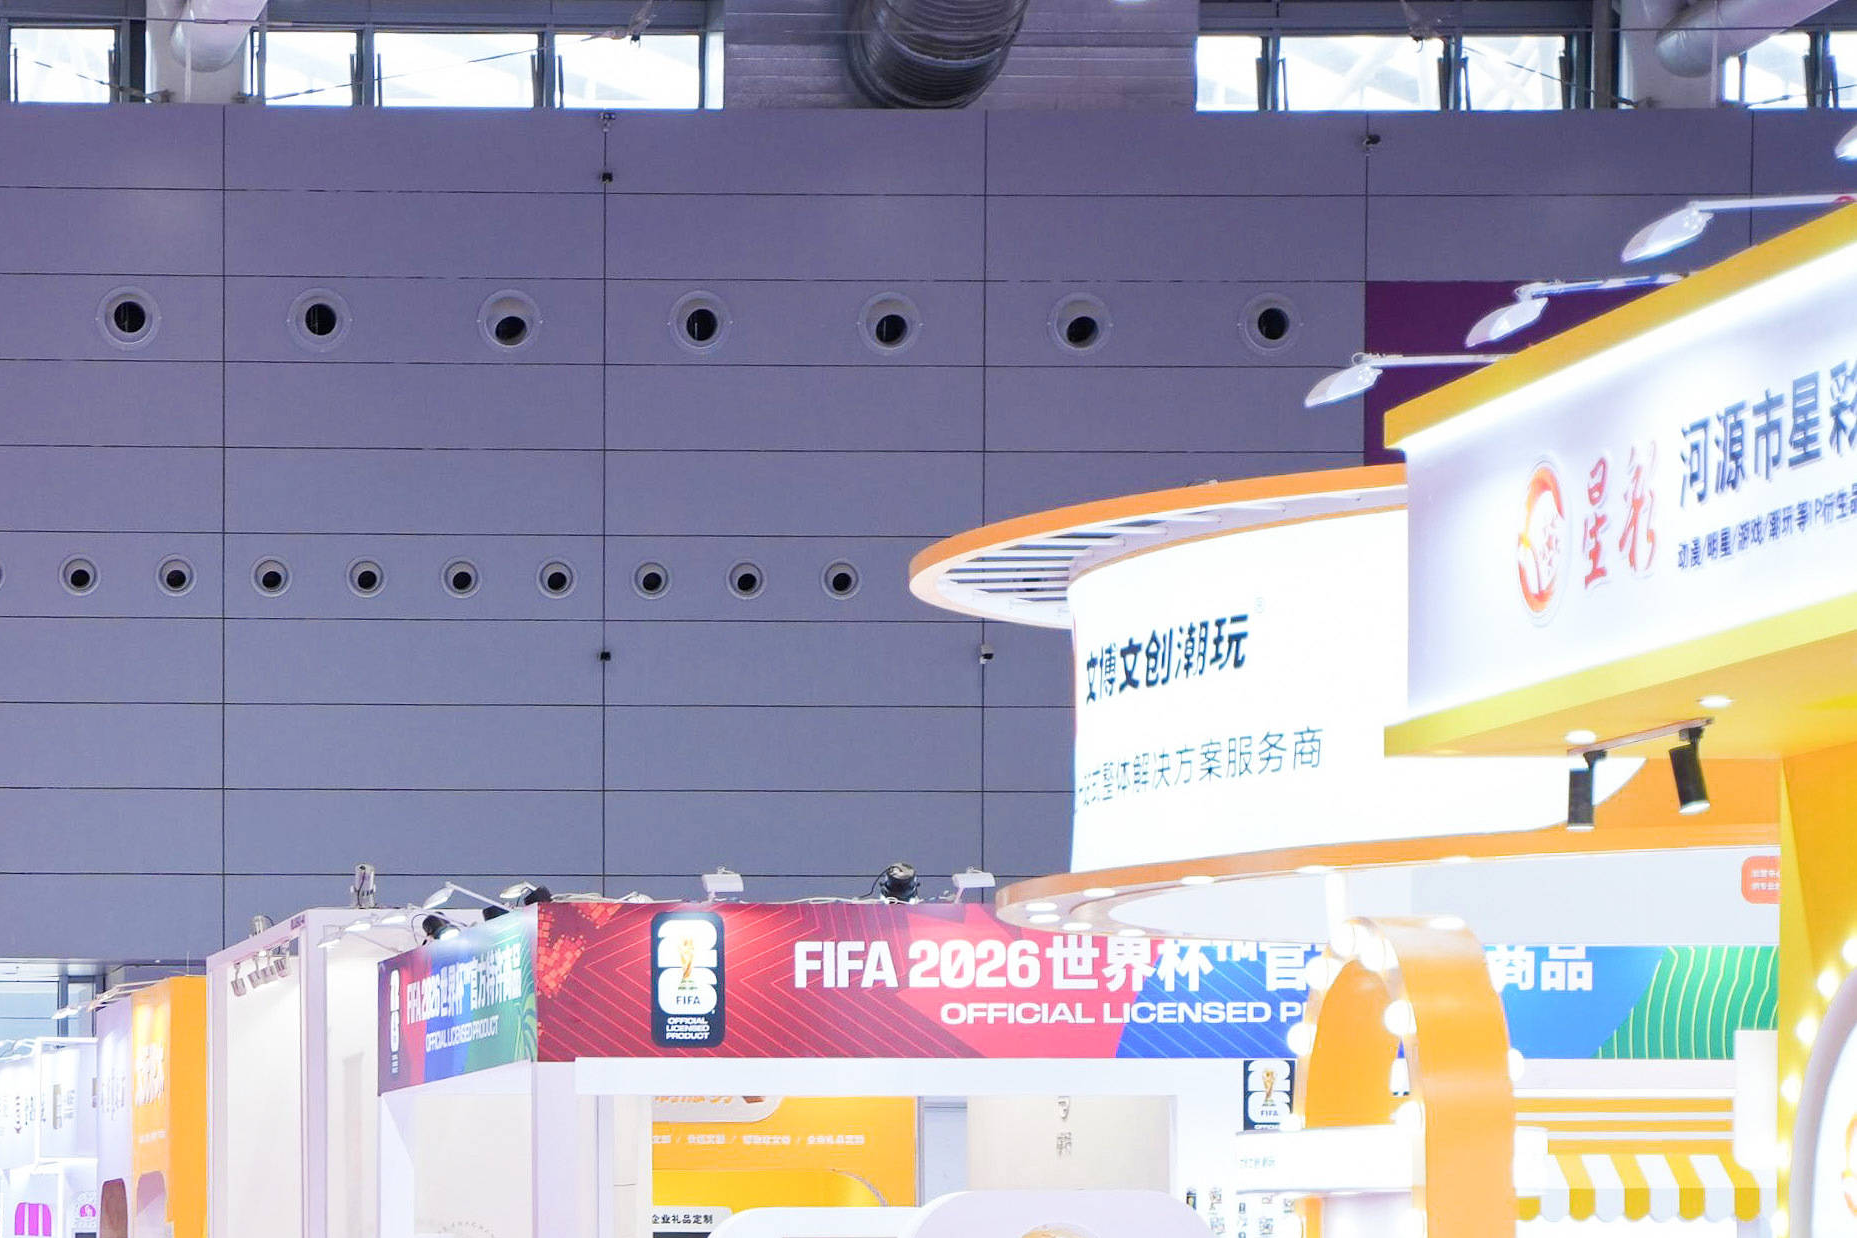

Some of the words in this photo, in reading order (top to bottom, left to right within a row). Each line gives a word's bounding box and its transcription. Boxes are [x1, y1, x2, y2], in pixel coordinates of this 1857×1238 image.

[1086, 612, 1250, 704] 文博文创潮玩
[793, 940, 899, 989] FIFA
[676, 995, 701, 1005] FIFA
[940, 1002, 1096, 1025] OFFICIAL
[1103, 1002, 1272, 1024] LICENSED
